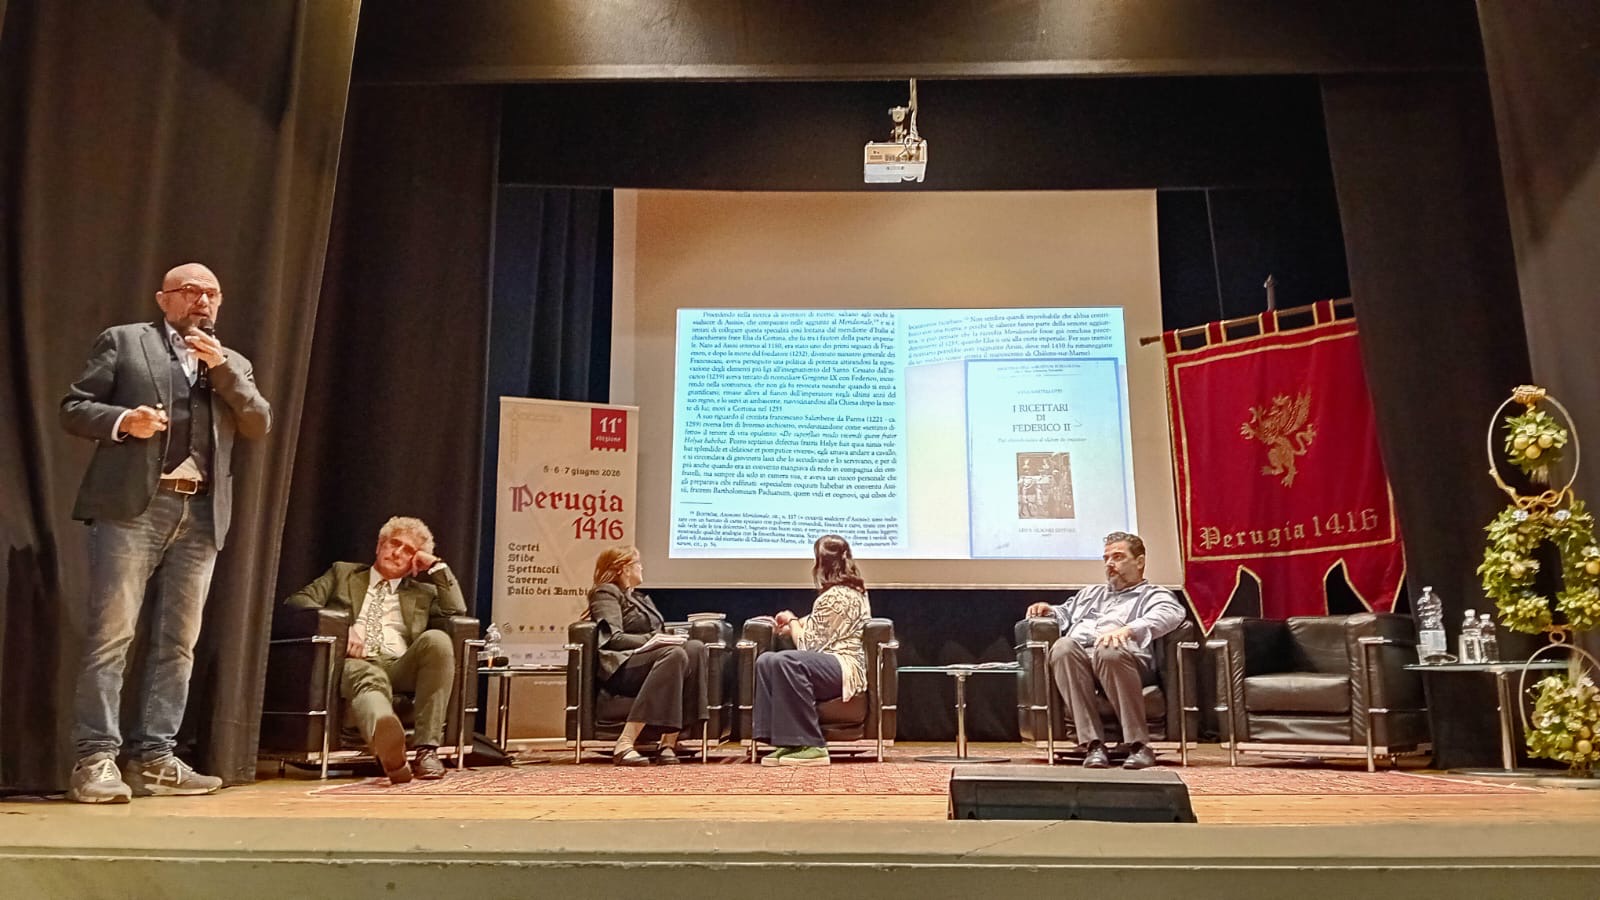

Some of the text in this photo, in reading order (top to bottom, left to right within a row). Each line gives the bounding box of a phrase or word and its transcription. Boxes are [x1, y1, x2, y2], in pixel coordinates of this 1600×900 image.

[1019, 404, 1068, 412] RICETTARI
[1012, 424, 1061, 432] FEDERICO
[571, 467, 600, 477] giugno
[509, 483, 624, 516] Perugia
[572, 516, 624, 540] 1416
[1199, 508, 1379, 550] Perugia 1416
[508, 543, 539, 552] Cortei
[508, 553, 535, 562] Sfide
[507, 564, 560, 574] Spettacoli
[507, 575, 548, 584] Taverne
[507, 586, 534, 596] Palio
[537, 587, 550, 595] dei
